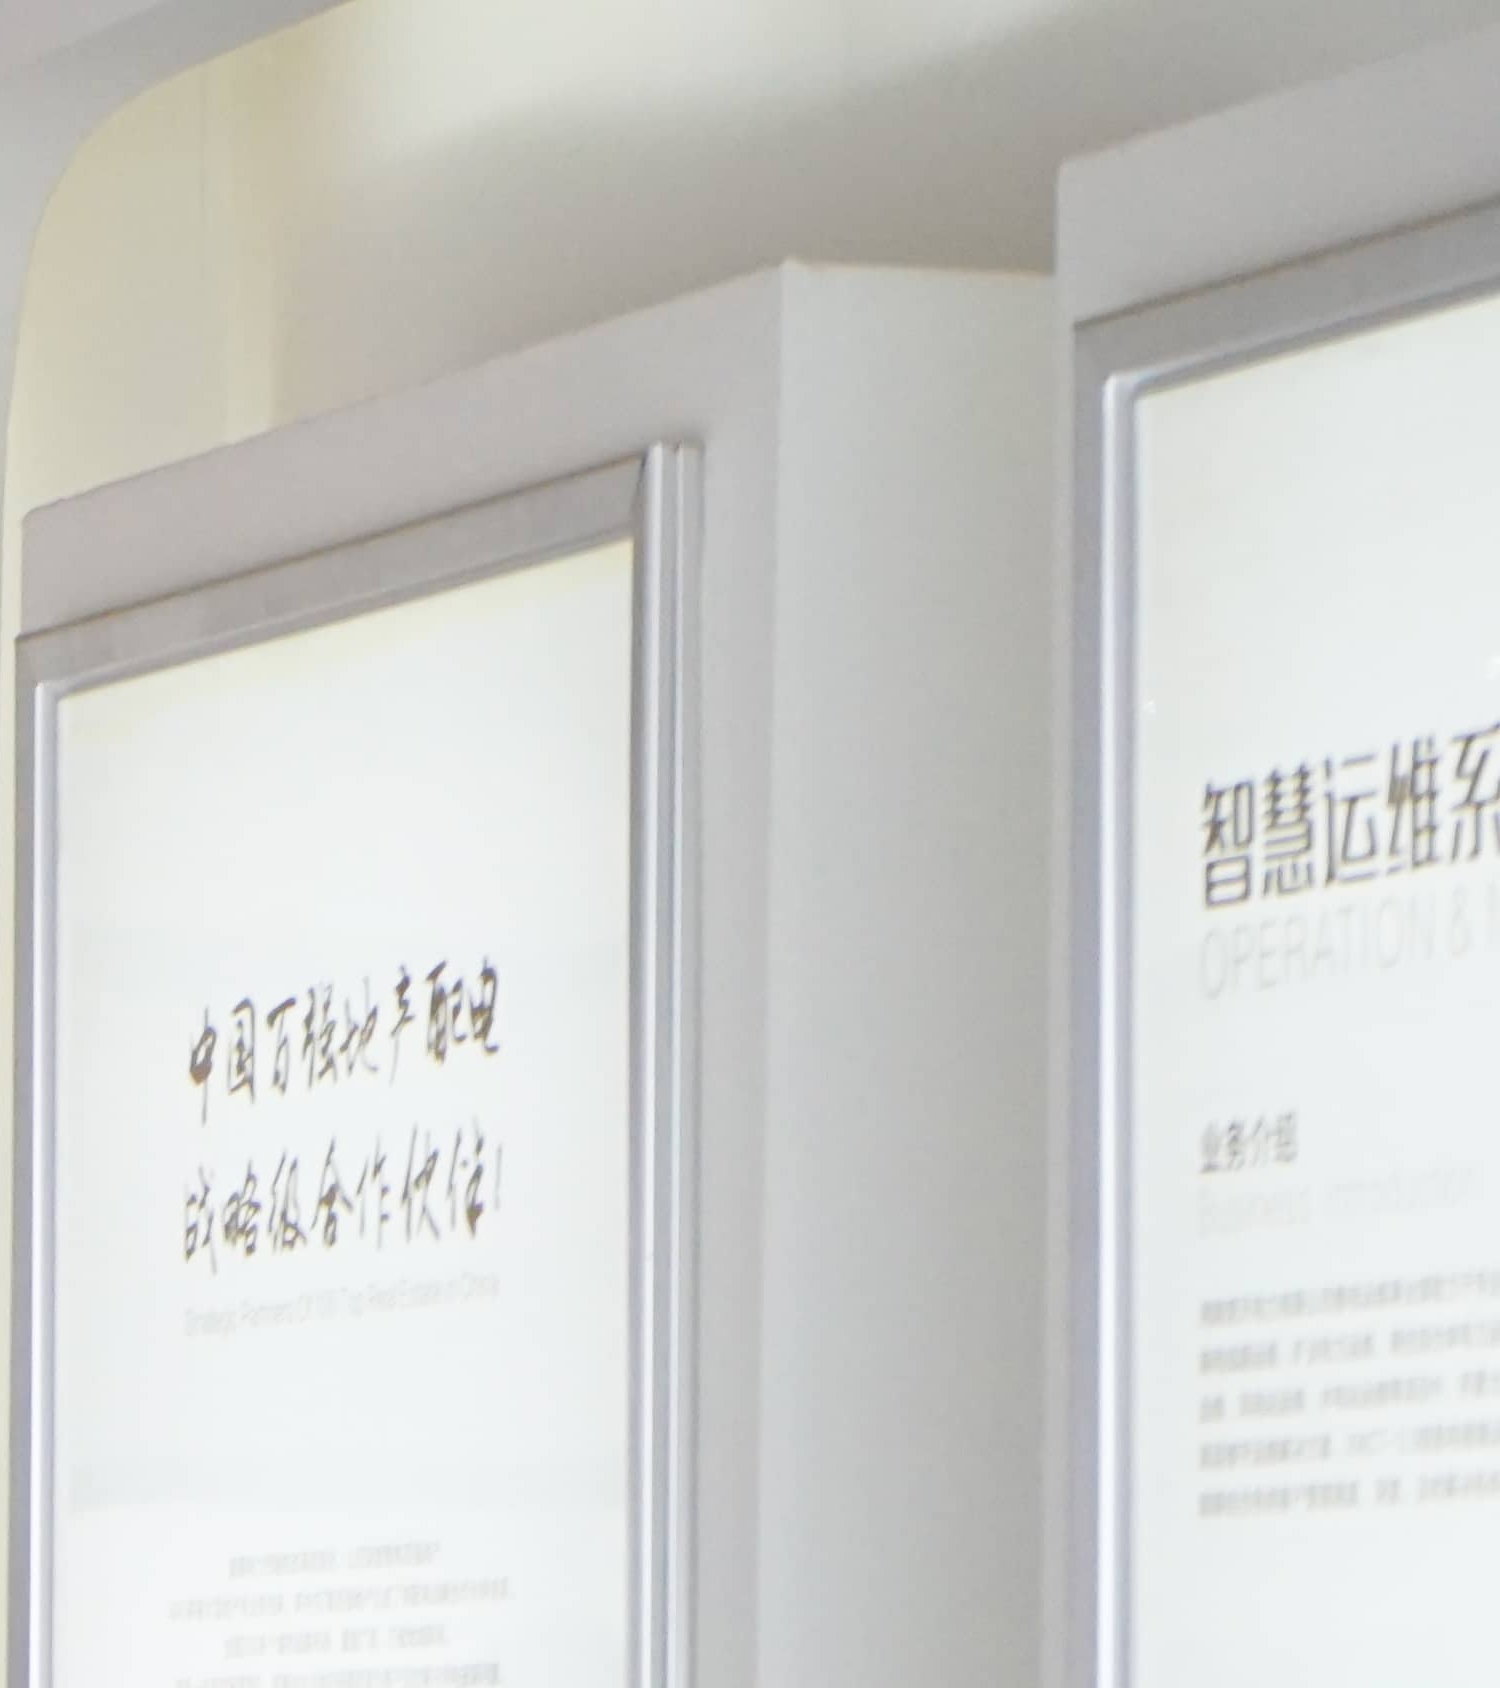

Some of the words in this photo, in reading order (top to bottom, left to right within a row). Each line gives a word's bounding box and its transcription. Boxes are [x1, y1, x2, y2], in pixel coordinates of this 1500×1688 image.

[187, 956, 501, 1125] 中国百强地产配电
